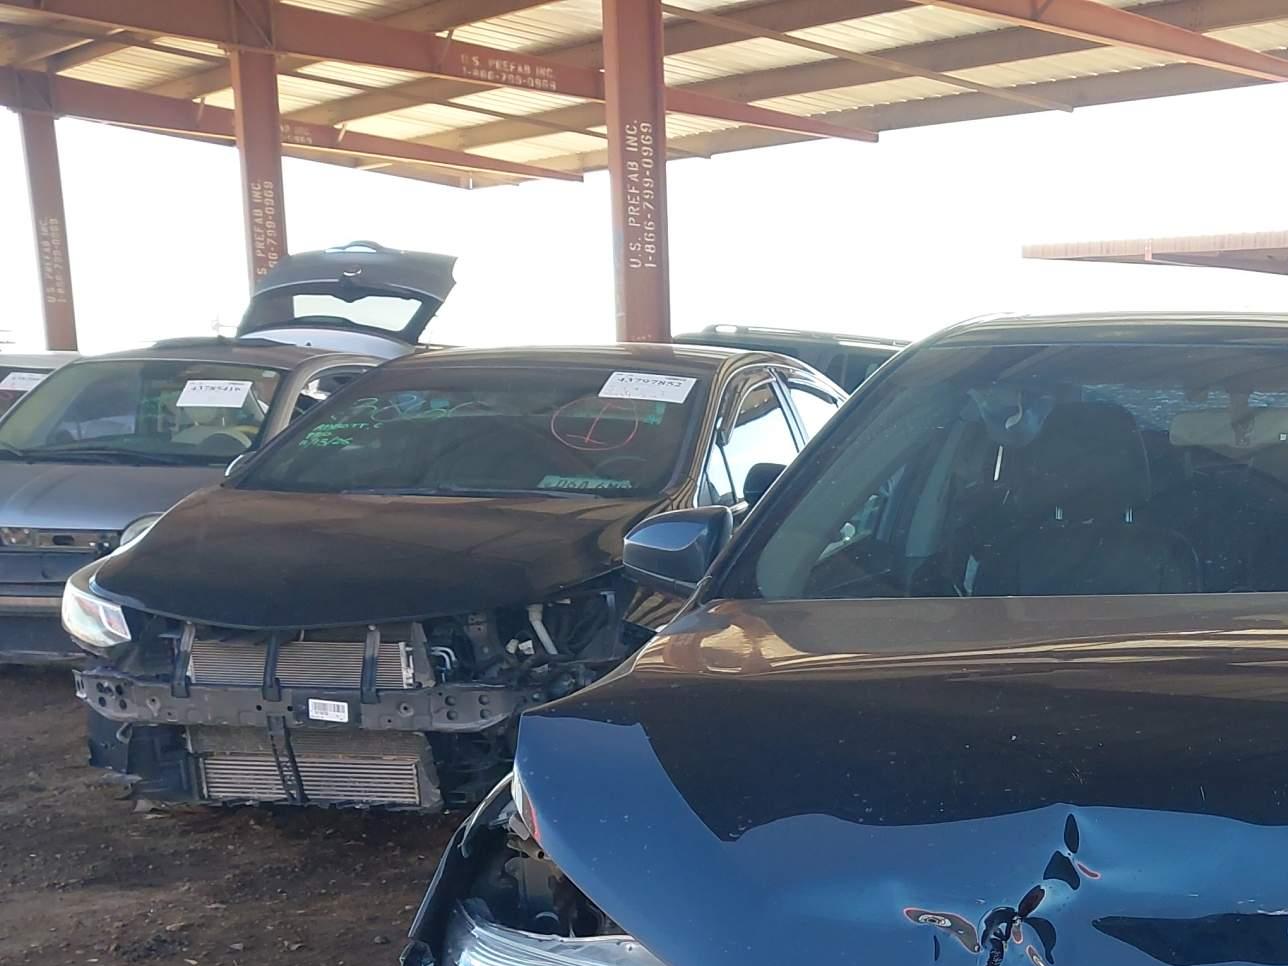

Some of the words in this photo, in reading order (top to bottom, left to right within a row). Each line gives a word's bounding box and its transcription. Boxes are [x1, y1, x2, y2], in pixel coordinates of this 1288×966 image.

[625, 119, 639, 151] INC.
[627, 160, 641, 227] PREFAB
[640, 121, 657, 268] 1-866-799-0969
[629, 237, 642, 268] U.S.
